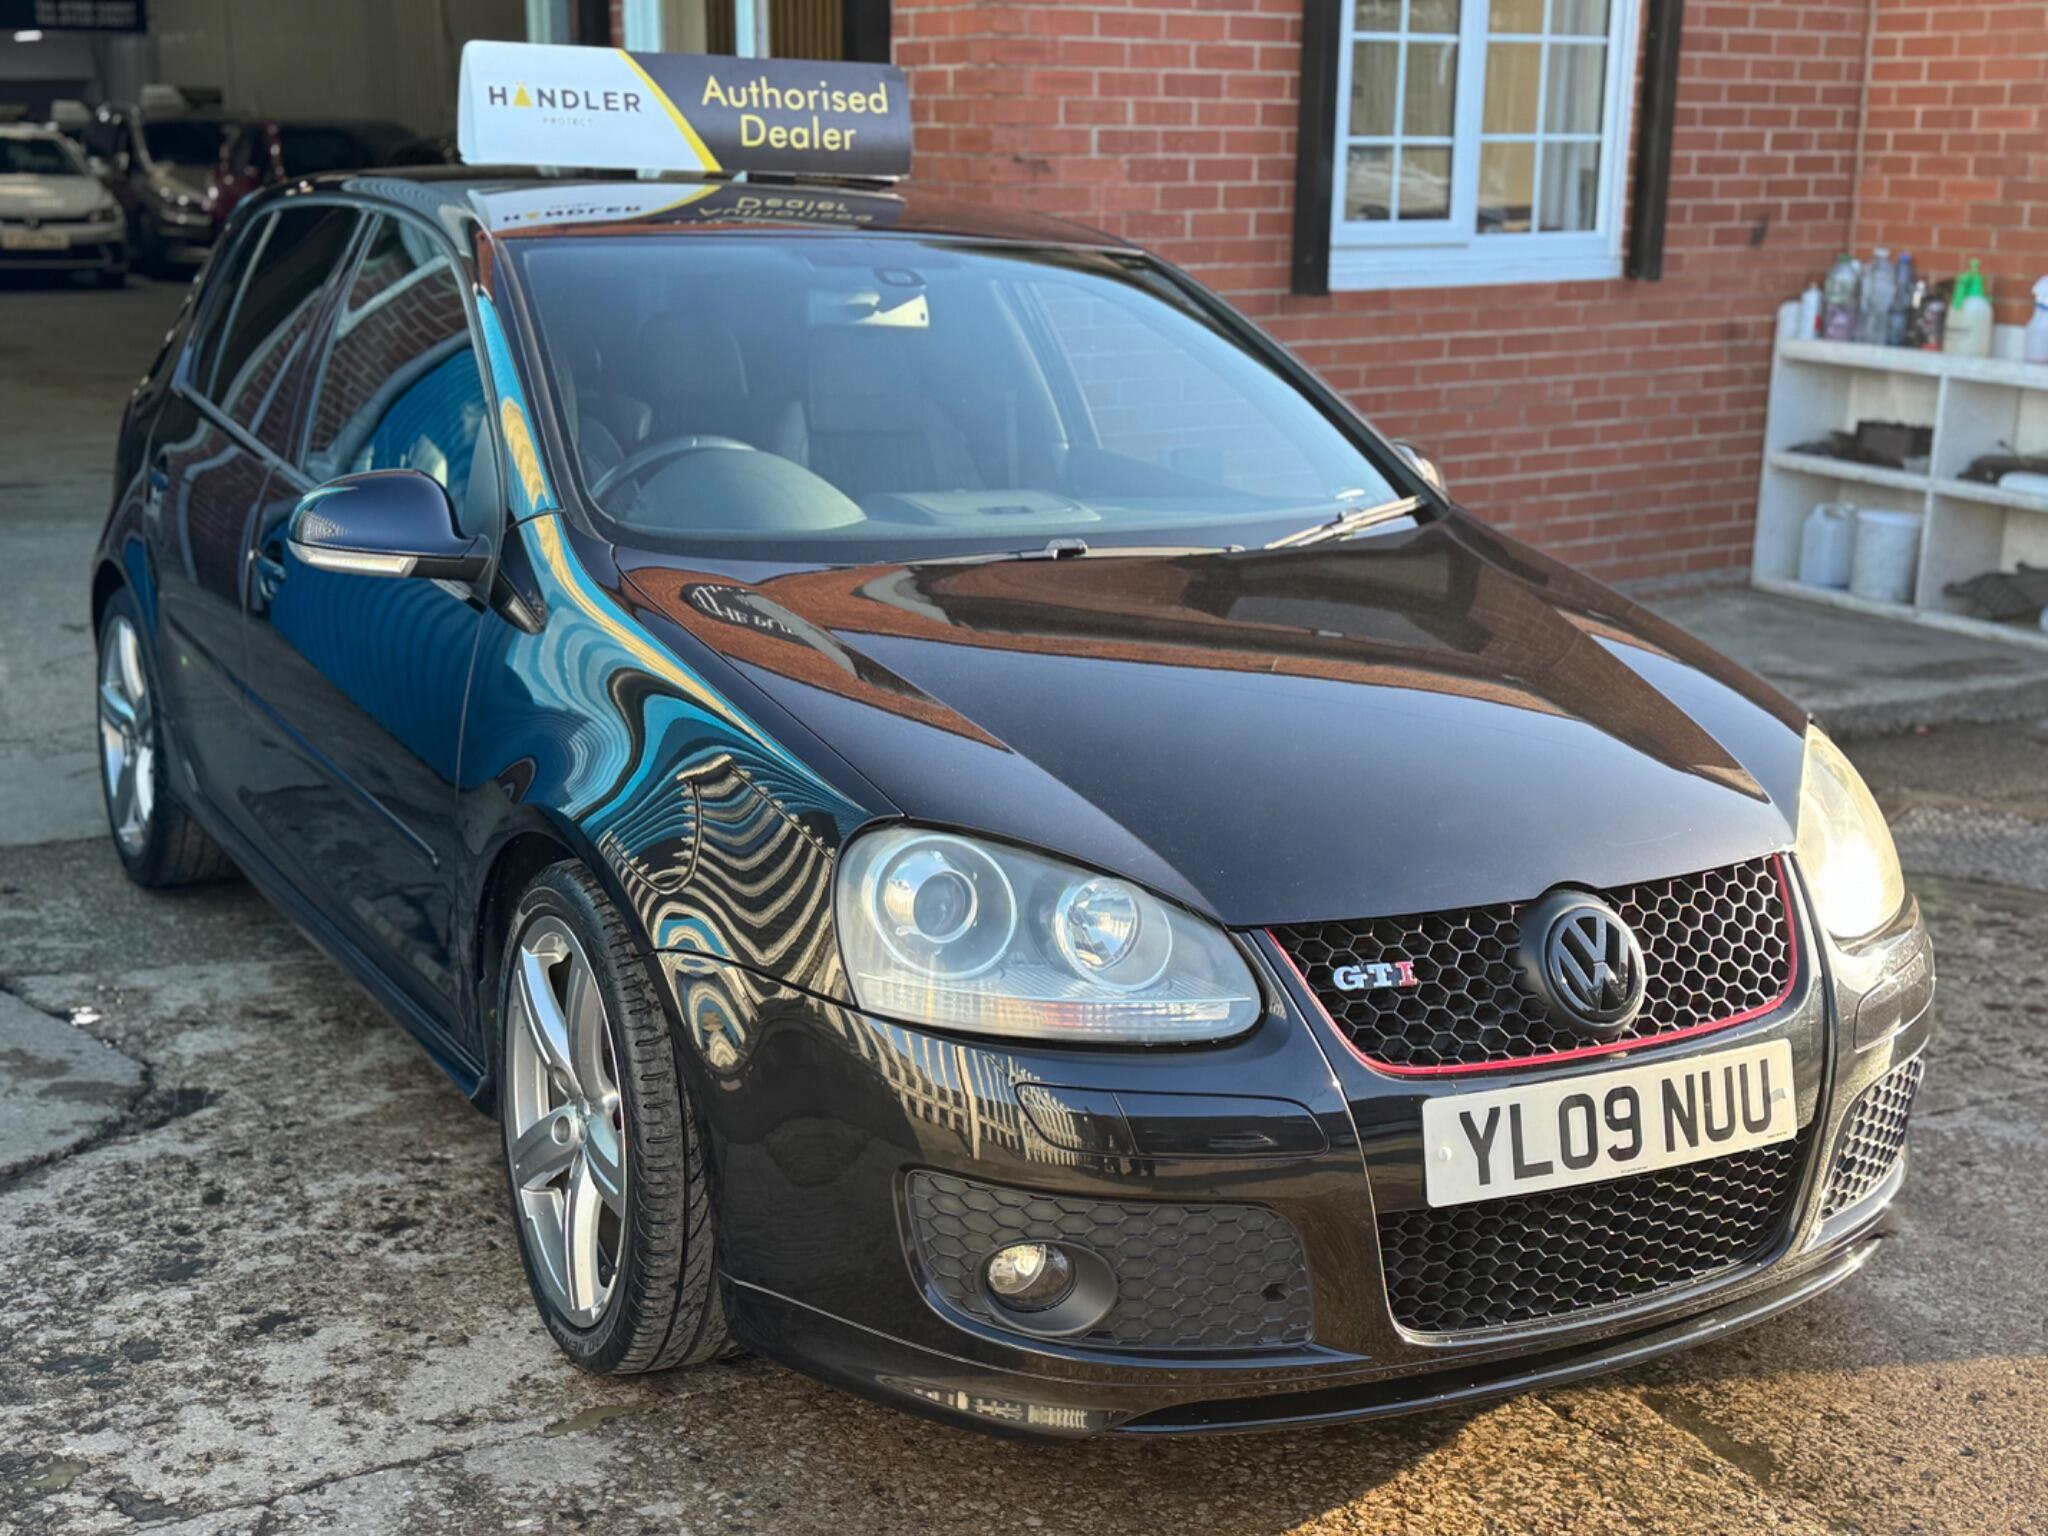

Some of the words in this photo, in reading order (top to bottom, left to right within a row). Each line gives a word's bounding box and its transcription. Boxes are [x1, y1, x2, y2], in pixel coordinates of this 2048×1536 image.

[701, 75, 889, 114] Authorised
[740, 114, 857, 151] Dealer
[1333, 961, 1418, 991] GTI
[1458, 1085, 1643, 1186] YL09
[1661, 1058, 1772, 1153] NUU
